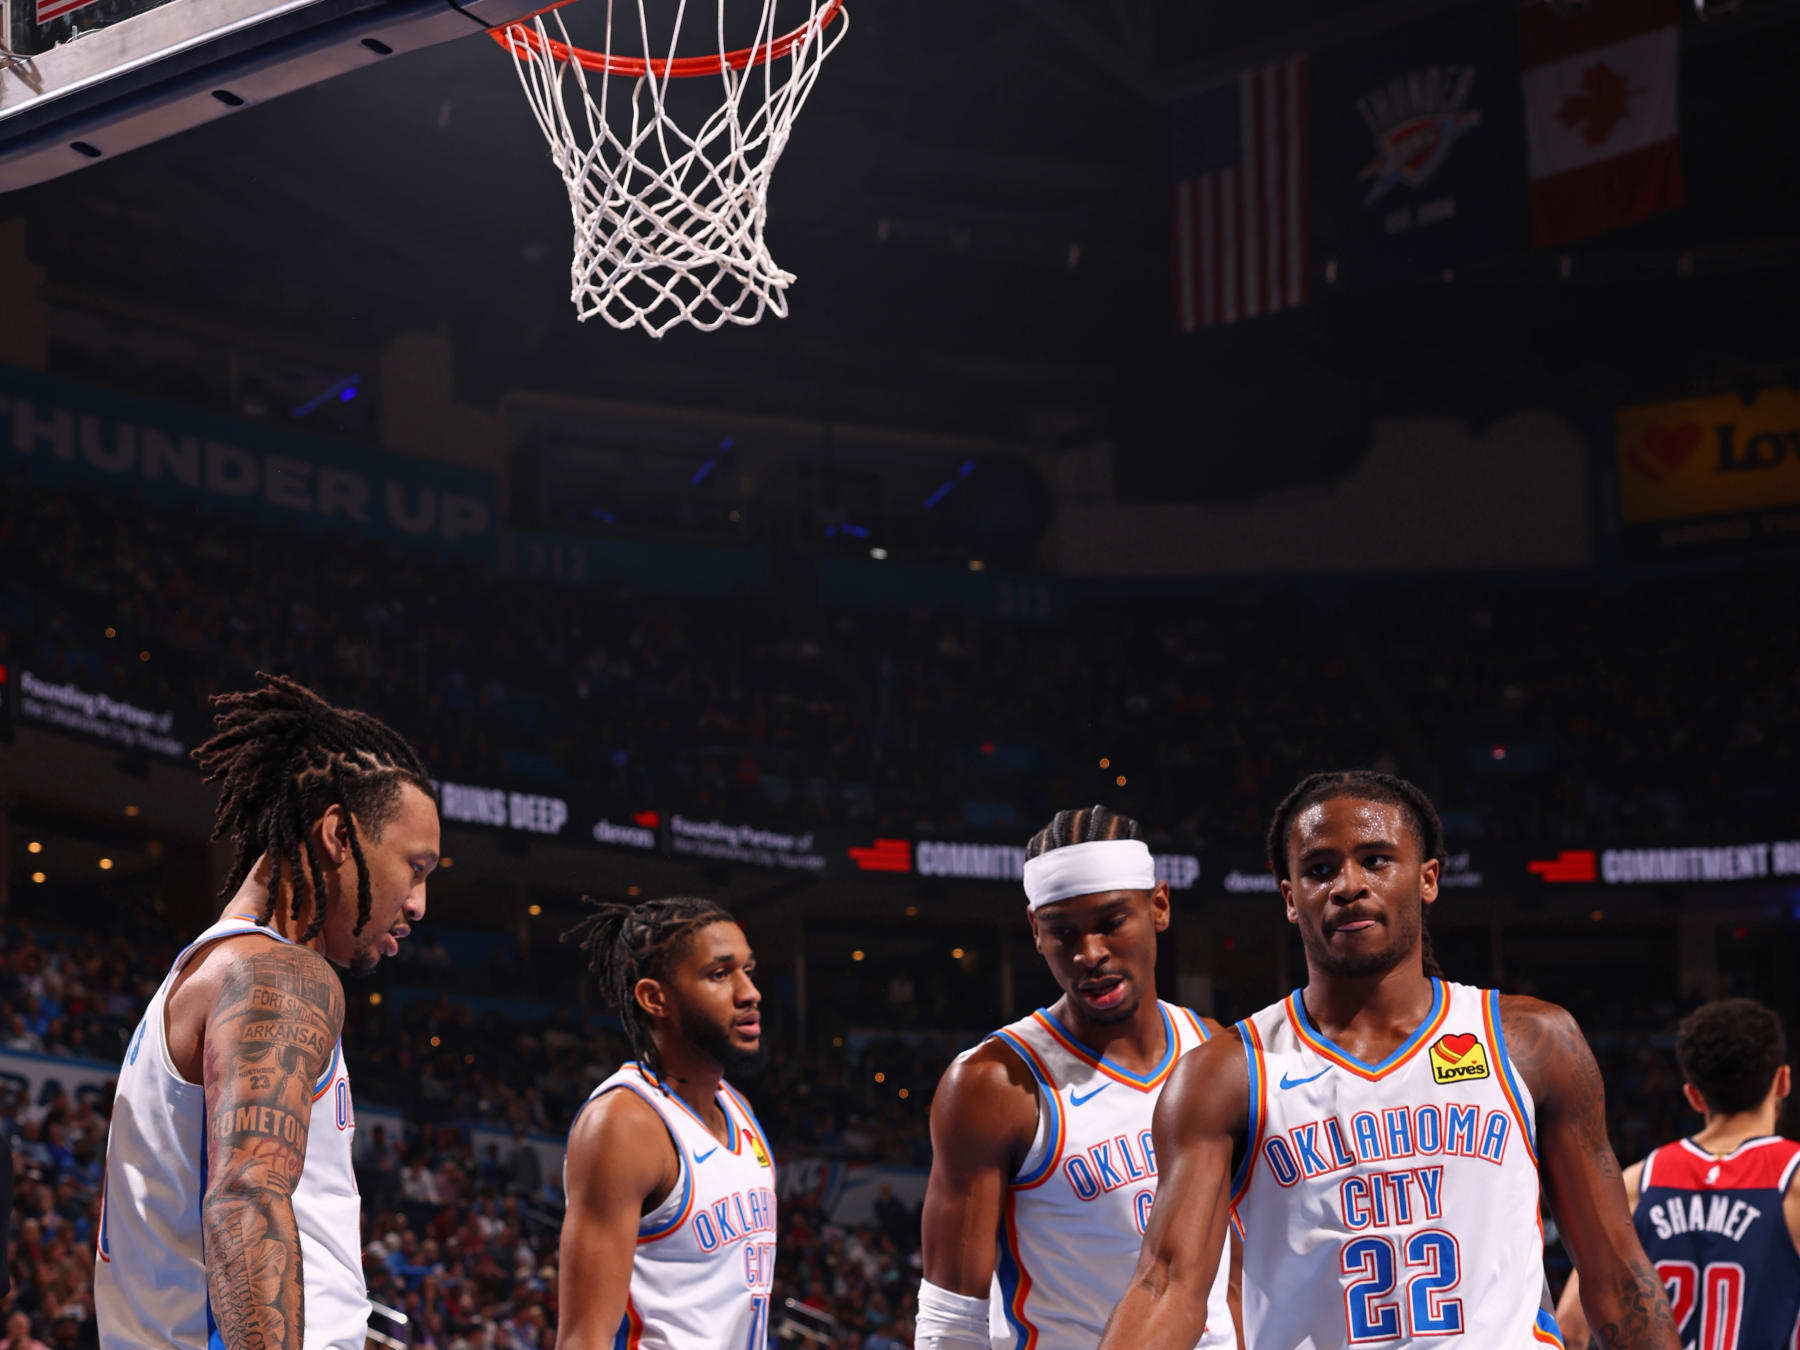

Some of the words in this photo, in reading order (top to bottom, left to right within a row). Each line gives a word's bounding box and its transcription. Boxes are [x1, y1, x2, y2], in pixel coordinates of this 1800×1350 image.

[0, 396, 372, 523] HUNDER
[384, 478, 490, 542] UP
[442, 783, 506, 829] RUNS
[509, 792, 568, 835] DEEP
[592, 818, 656, 848] devon
[1602, 843, 1768, 884] COMMITMENT
[252, 989, 286, 1007] FORT
[244, 1025, 325, 1054] ARKANSAS
[250, 1075, 270, 1090] 23
[1263, 1103, 1511, 1187] OKLAHOMA
[1340, 1165, 1444, 1231] CITY
[1649, 1194, 1761, 1241] SHAMET
[1340, 1228, 1464, 1344] 22
